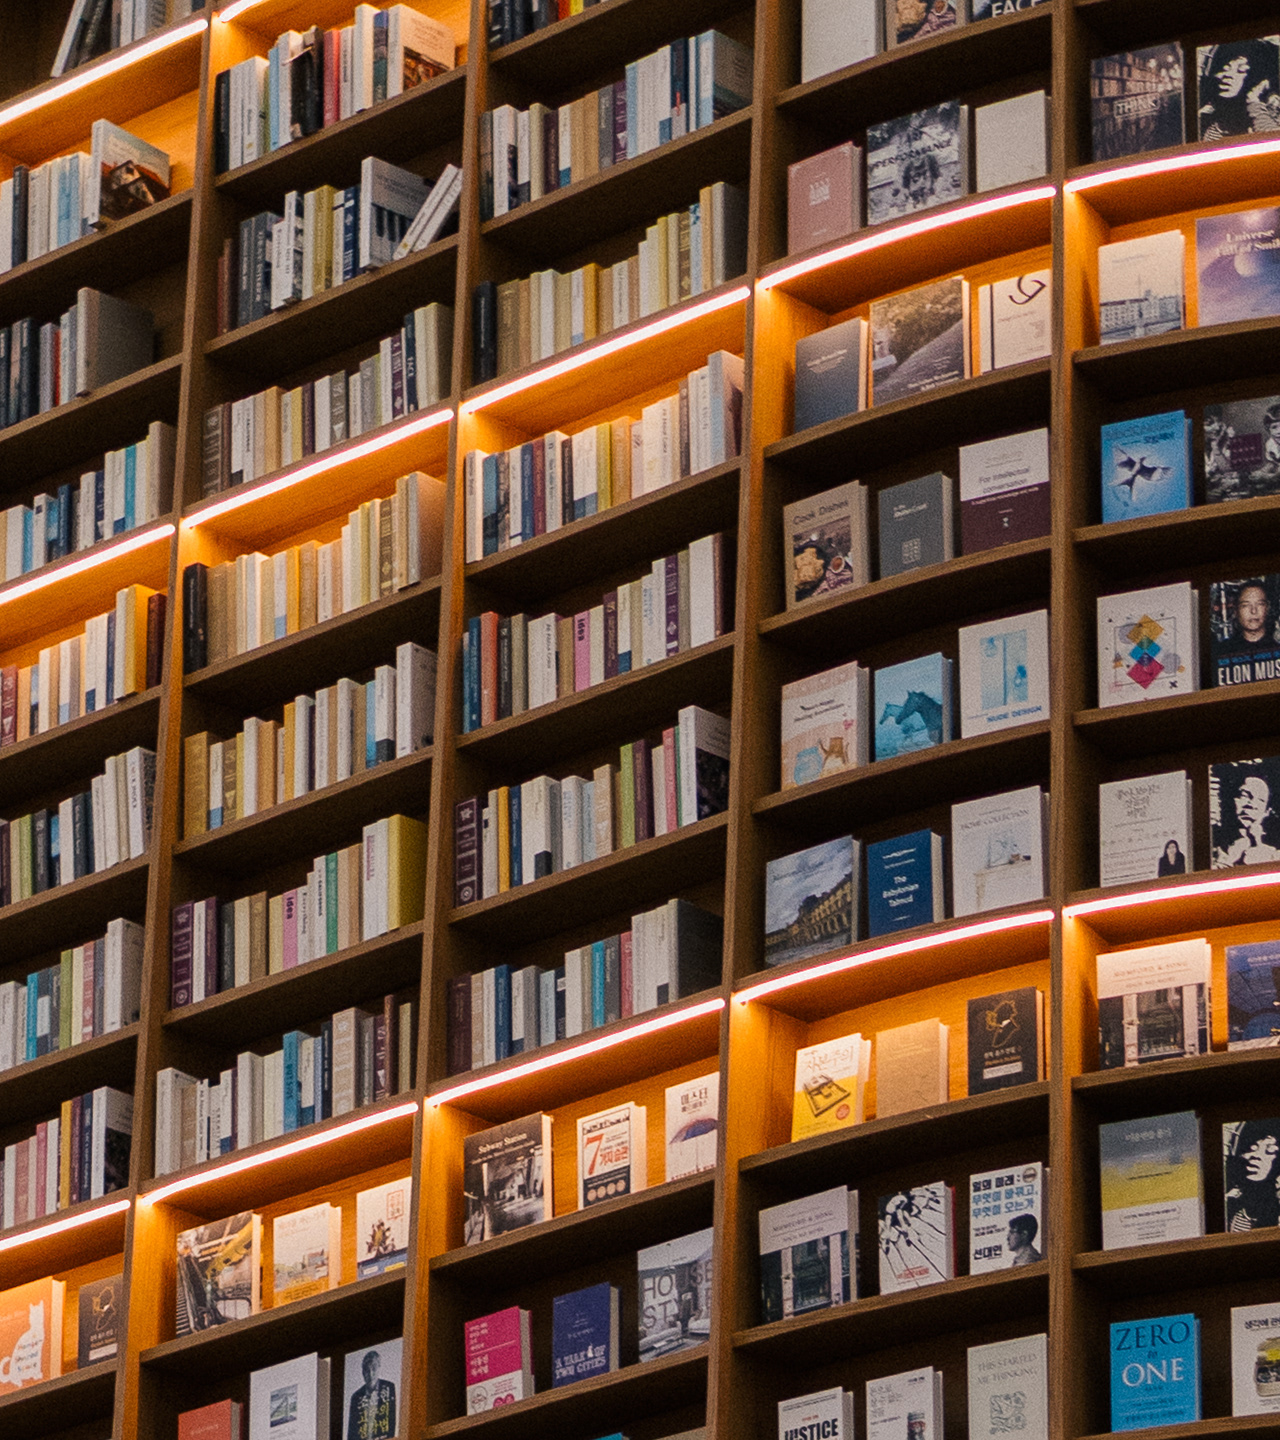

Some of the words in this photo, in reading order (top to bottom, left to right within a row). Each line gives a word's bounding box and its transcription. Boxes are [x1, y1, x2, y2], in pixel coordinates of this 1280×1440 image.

[1217, 662, 1251, 686] ELON
[1115, 1321, 1191, 1351] ZERO
[1121, 1357, 1185, 1388] ONE
